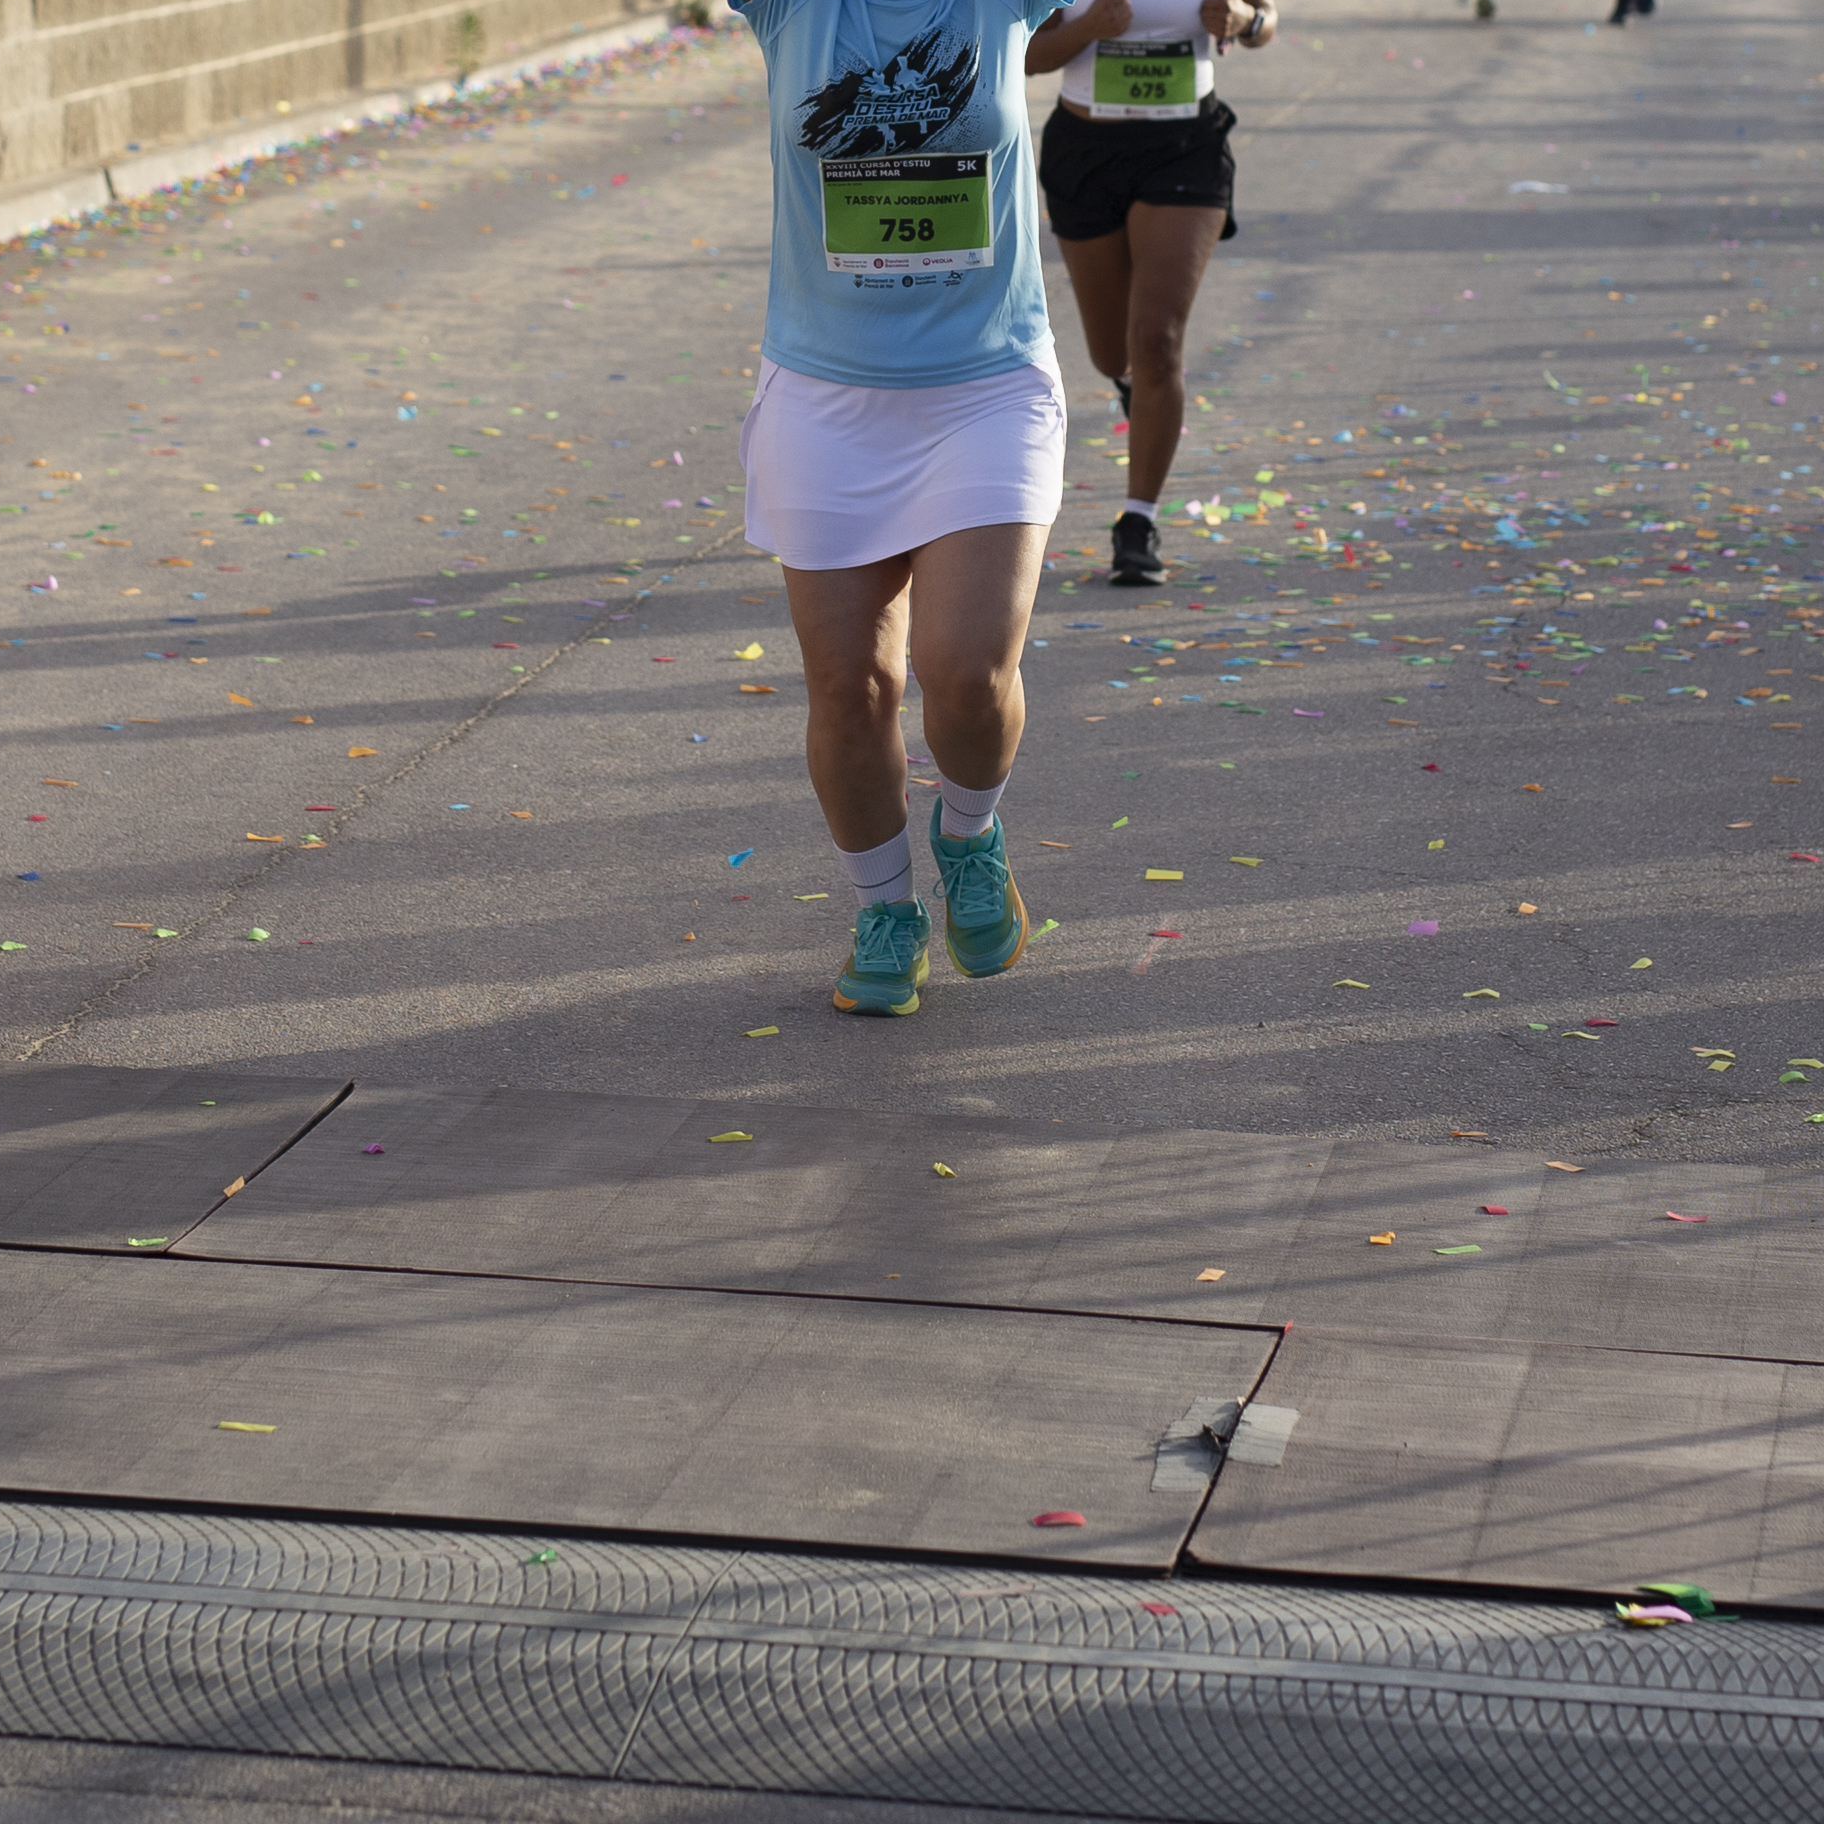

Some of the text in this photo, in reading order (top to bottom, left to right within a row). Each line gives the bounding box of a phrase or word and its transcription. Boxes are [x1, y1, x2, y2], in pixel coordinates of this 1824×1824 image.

[1123, 65, 1173, 77] DIANA
[875, 86, 939, 103] CURSA
[1130, 81, 1166, 98] 675
[856, 98, 930, 116] D'ESTIU
[898, 112, 917, 121] DE
[917, 109, 948, 120] MAR
[860, 161, 891, 169] CURSA
[893, 160, 931, 168] D'ESTIU
[957, 160, 977, 171] 5K
[826, 169, 862, 178] PREMIÀ
[880, 169, 901, 177] MAR
[844, 193, 969, 206] TASSYA JORDANNYA
[879, 218, 935, 242] 758
